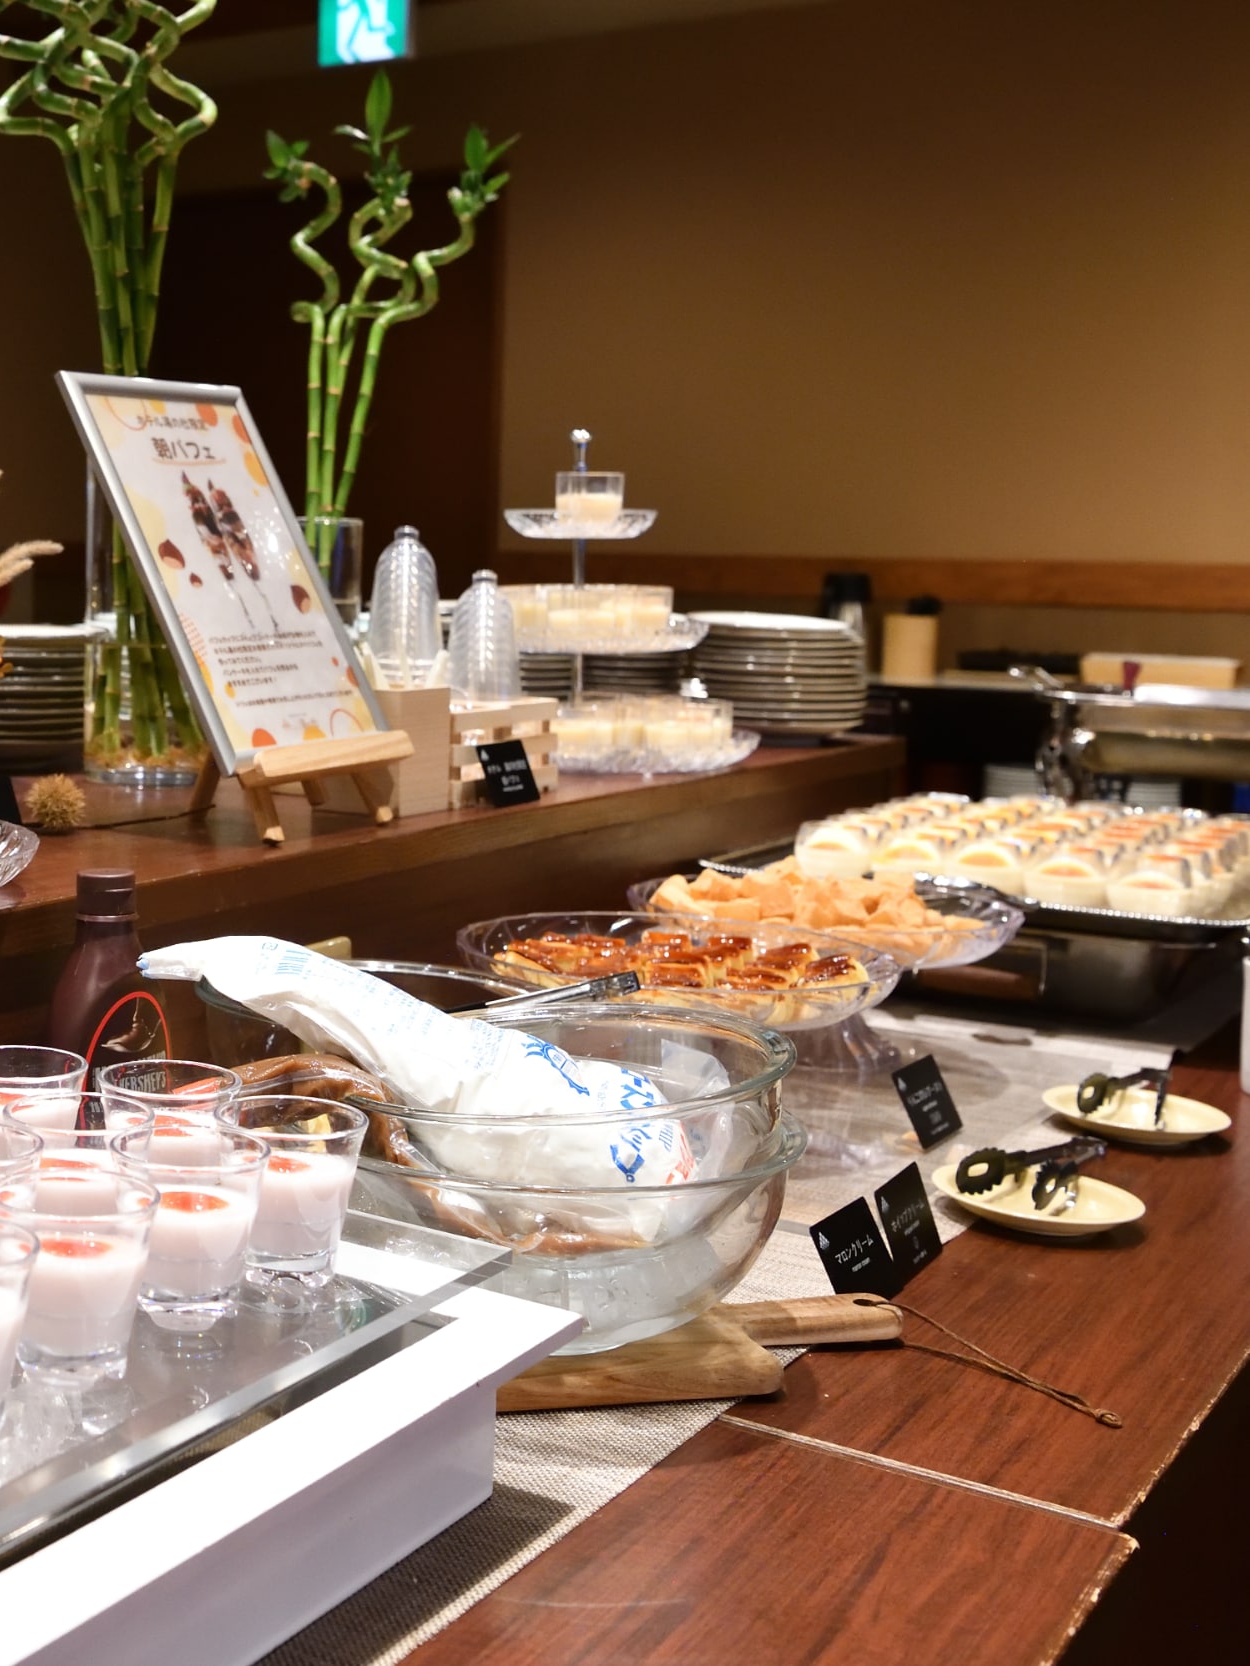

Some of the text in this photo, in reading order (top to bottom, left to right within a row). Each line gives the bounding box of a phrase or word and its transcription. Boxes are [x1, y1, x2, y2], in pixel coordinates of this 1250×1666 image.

[835, 1234, 874, 1264] マロンクリーム
